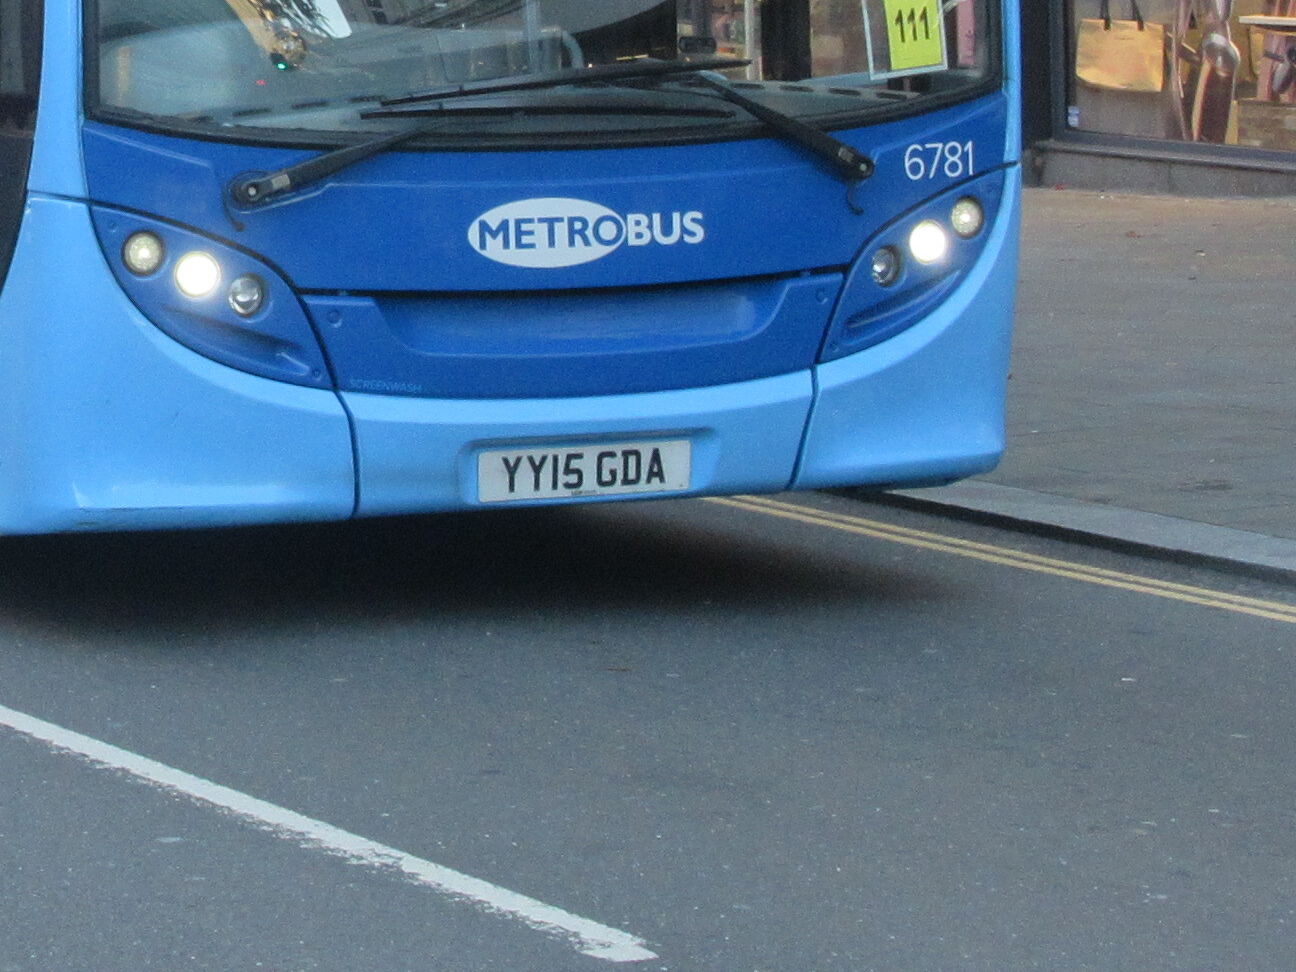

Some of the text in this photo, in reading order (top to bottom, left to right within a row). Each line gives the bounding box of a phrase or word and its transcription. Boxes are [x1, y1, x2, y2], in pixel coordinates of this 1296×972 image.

[895, 6, 930, 44] 111
[904, 140, 974, 181] 6781
[477, 210, 705, 251] METROBUS
[501, 447, 667, 494] YY15 GDA
